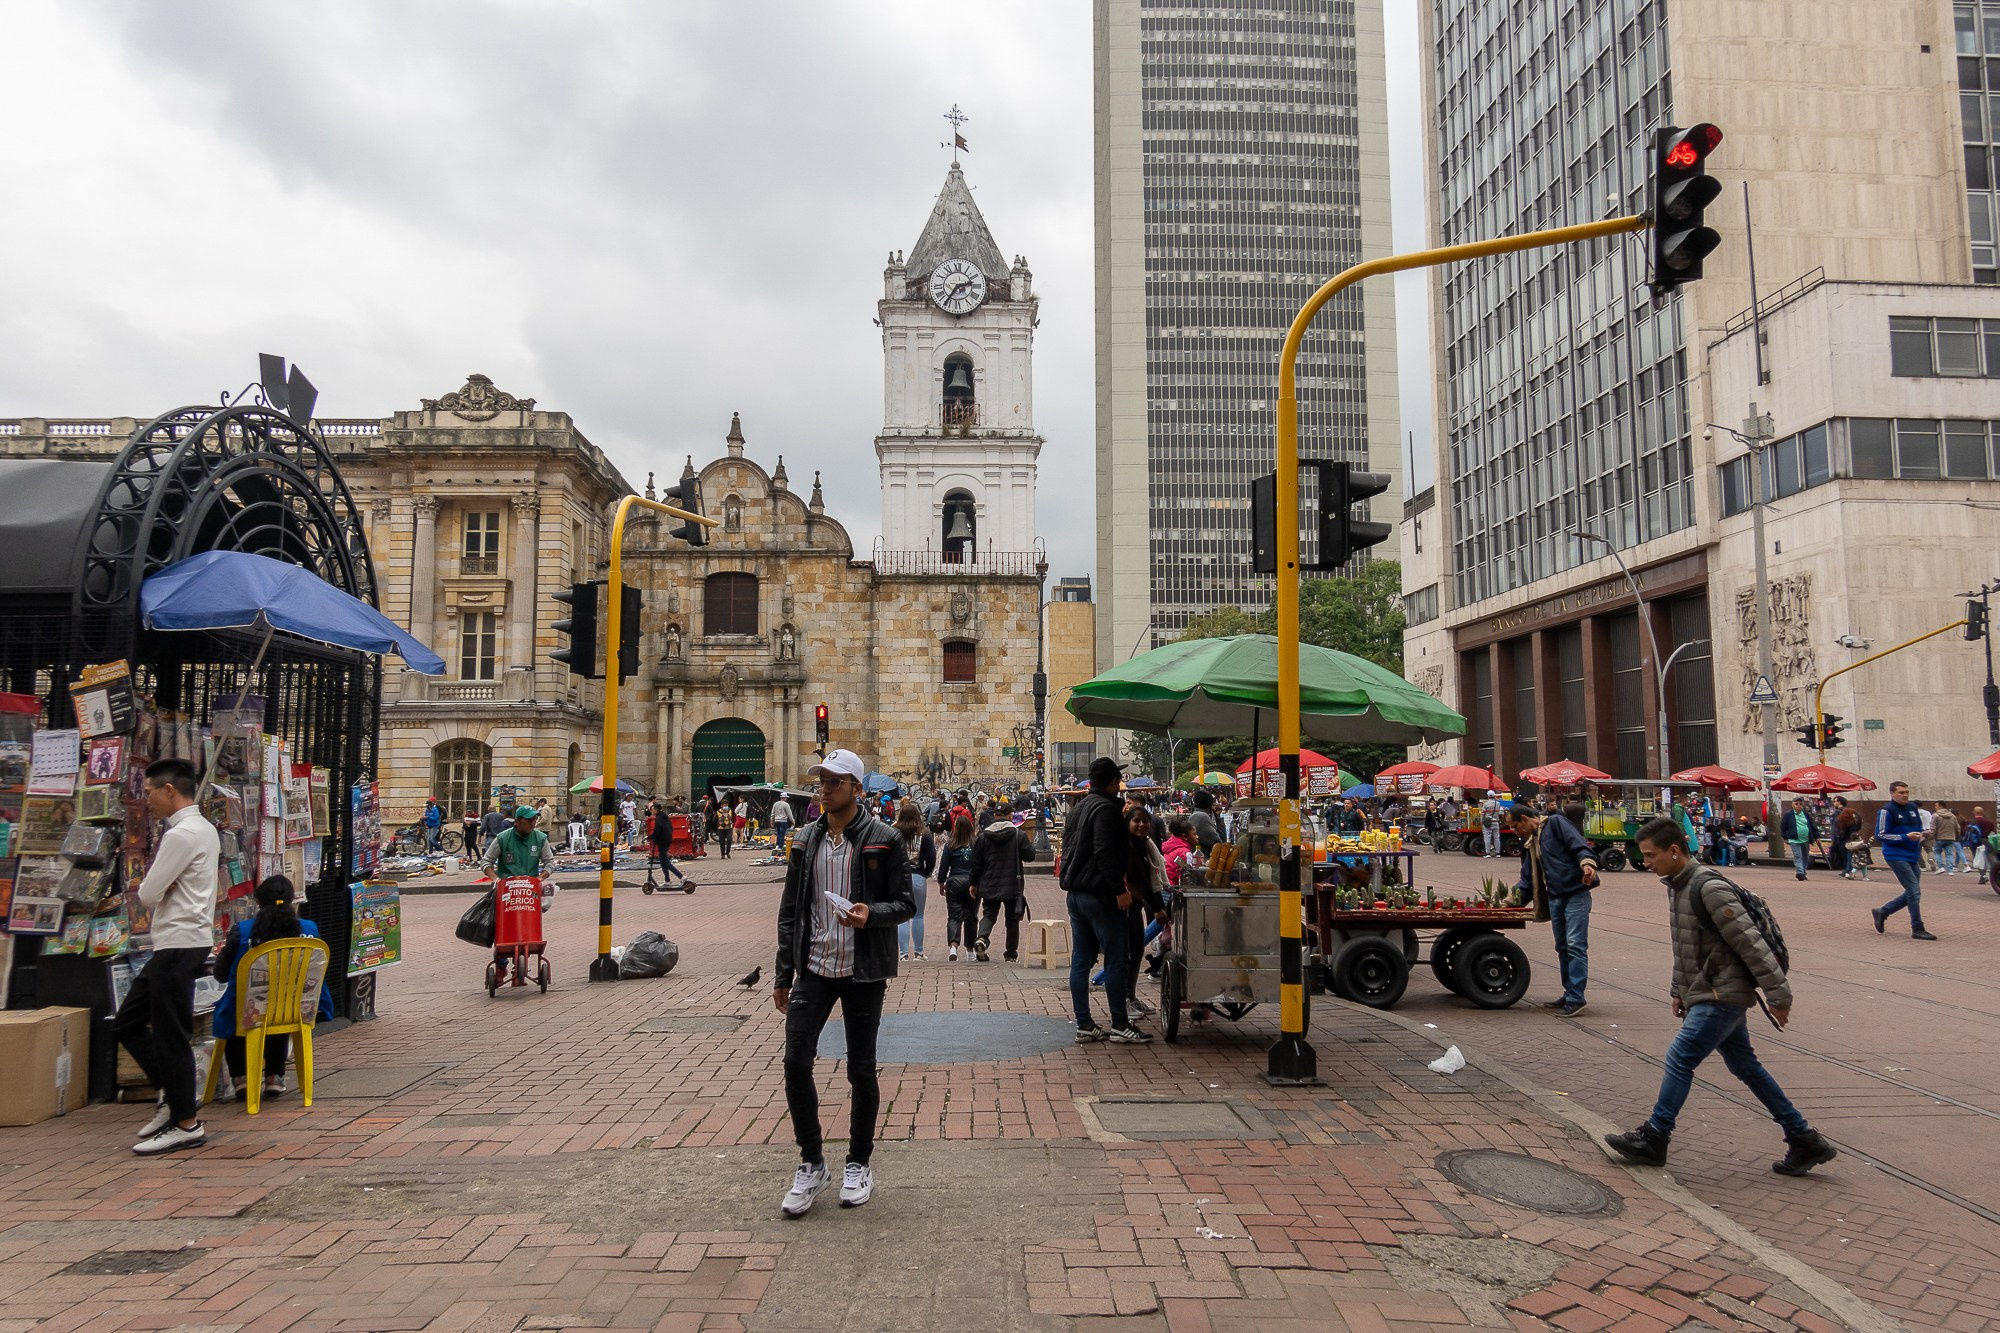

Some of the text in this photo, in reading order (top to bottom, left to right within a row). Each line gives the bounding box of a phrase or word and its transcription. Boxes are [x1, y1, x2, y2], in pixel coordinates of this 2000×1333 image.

[1490, 574, 1645, 633] BANCO DE LA REPUBLICA
[509, 888, 532, 896] TINTO
[505, 897, 535, 906] PERICO
